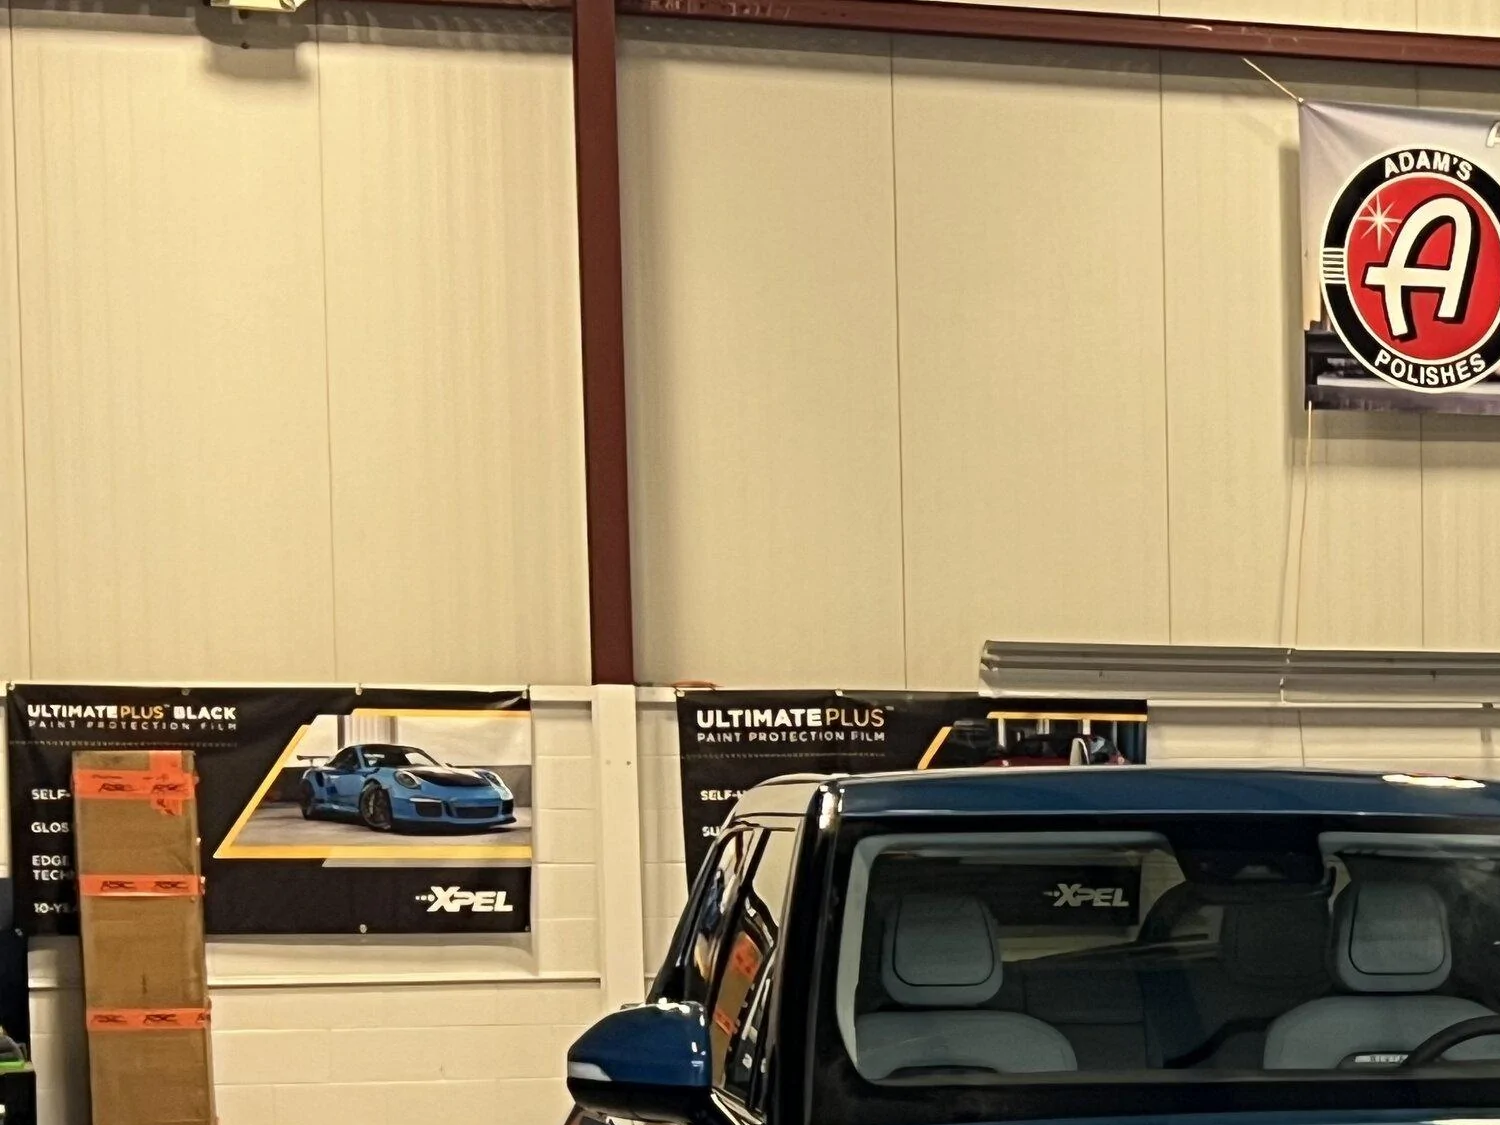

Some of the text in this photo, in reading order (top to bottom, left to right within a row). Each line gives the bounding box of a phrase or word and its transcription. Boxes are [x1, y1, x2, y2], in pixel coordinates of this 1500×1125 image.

[1384, 150, 1473, 182] ADAM'S
[1374, 348, 1486, 386] POLISHES
[173, 706, 237, 720] BLACK
[28, 720, 237, 731] PAINT PROTECTION FILM
[697, 731, 885, 743] PAINT PROTECTION FILM
[427, 886, 514, 912] XPEL
[1053, 884, 1130, 907] XPEL
